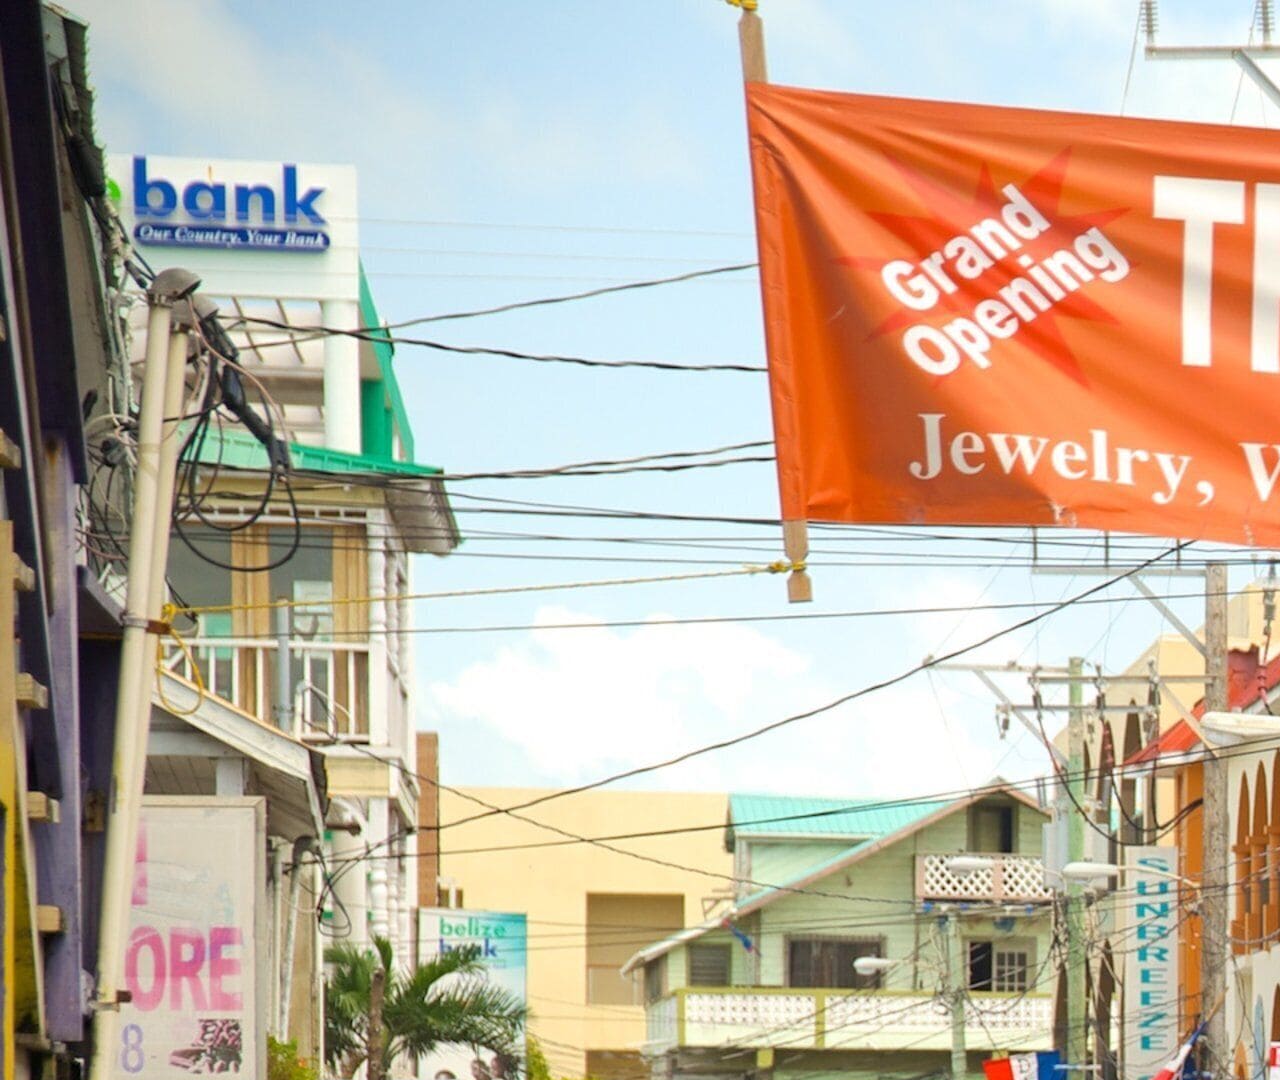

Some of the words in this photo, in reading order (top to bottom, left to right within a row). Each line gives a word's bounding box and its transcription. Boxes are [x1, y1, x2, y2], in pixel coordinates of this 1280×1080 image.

[133, 156, 326, 225] bank
[139, 224, 171, 241] Our
[246, 229, 280, 244] Your
[284, 232, 326, 247] Bank
[880, 182, 1051, 311] Grand
[901, 223, 1131, 376] Opening
[908, 413, 1216, 506] Jewelry,
[124, 926, 244, 1012] ORE
[440, 917, 506, 939] belize
[1136, 857, 1169, 1051] SUNBREEZE
